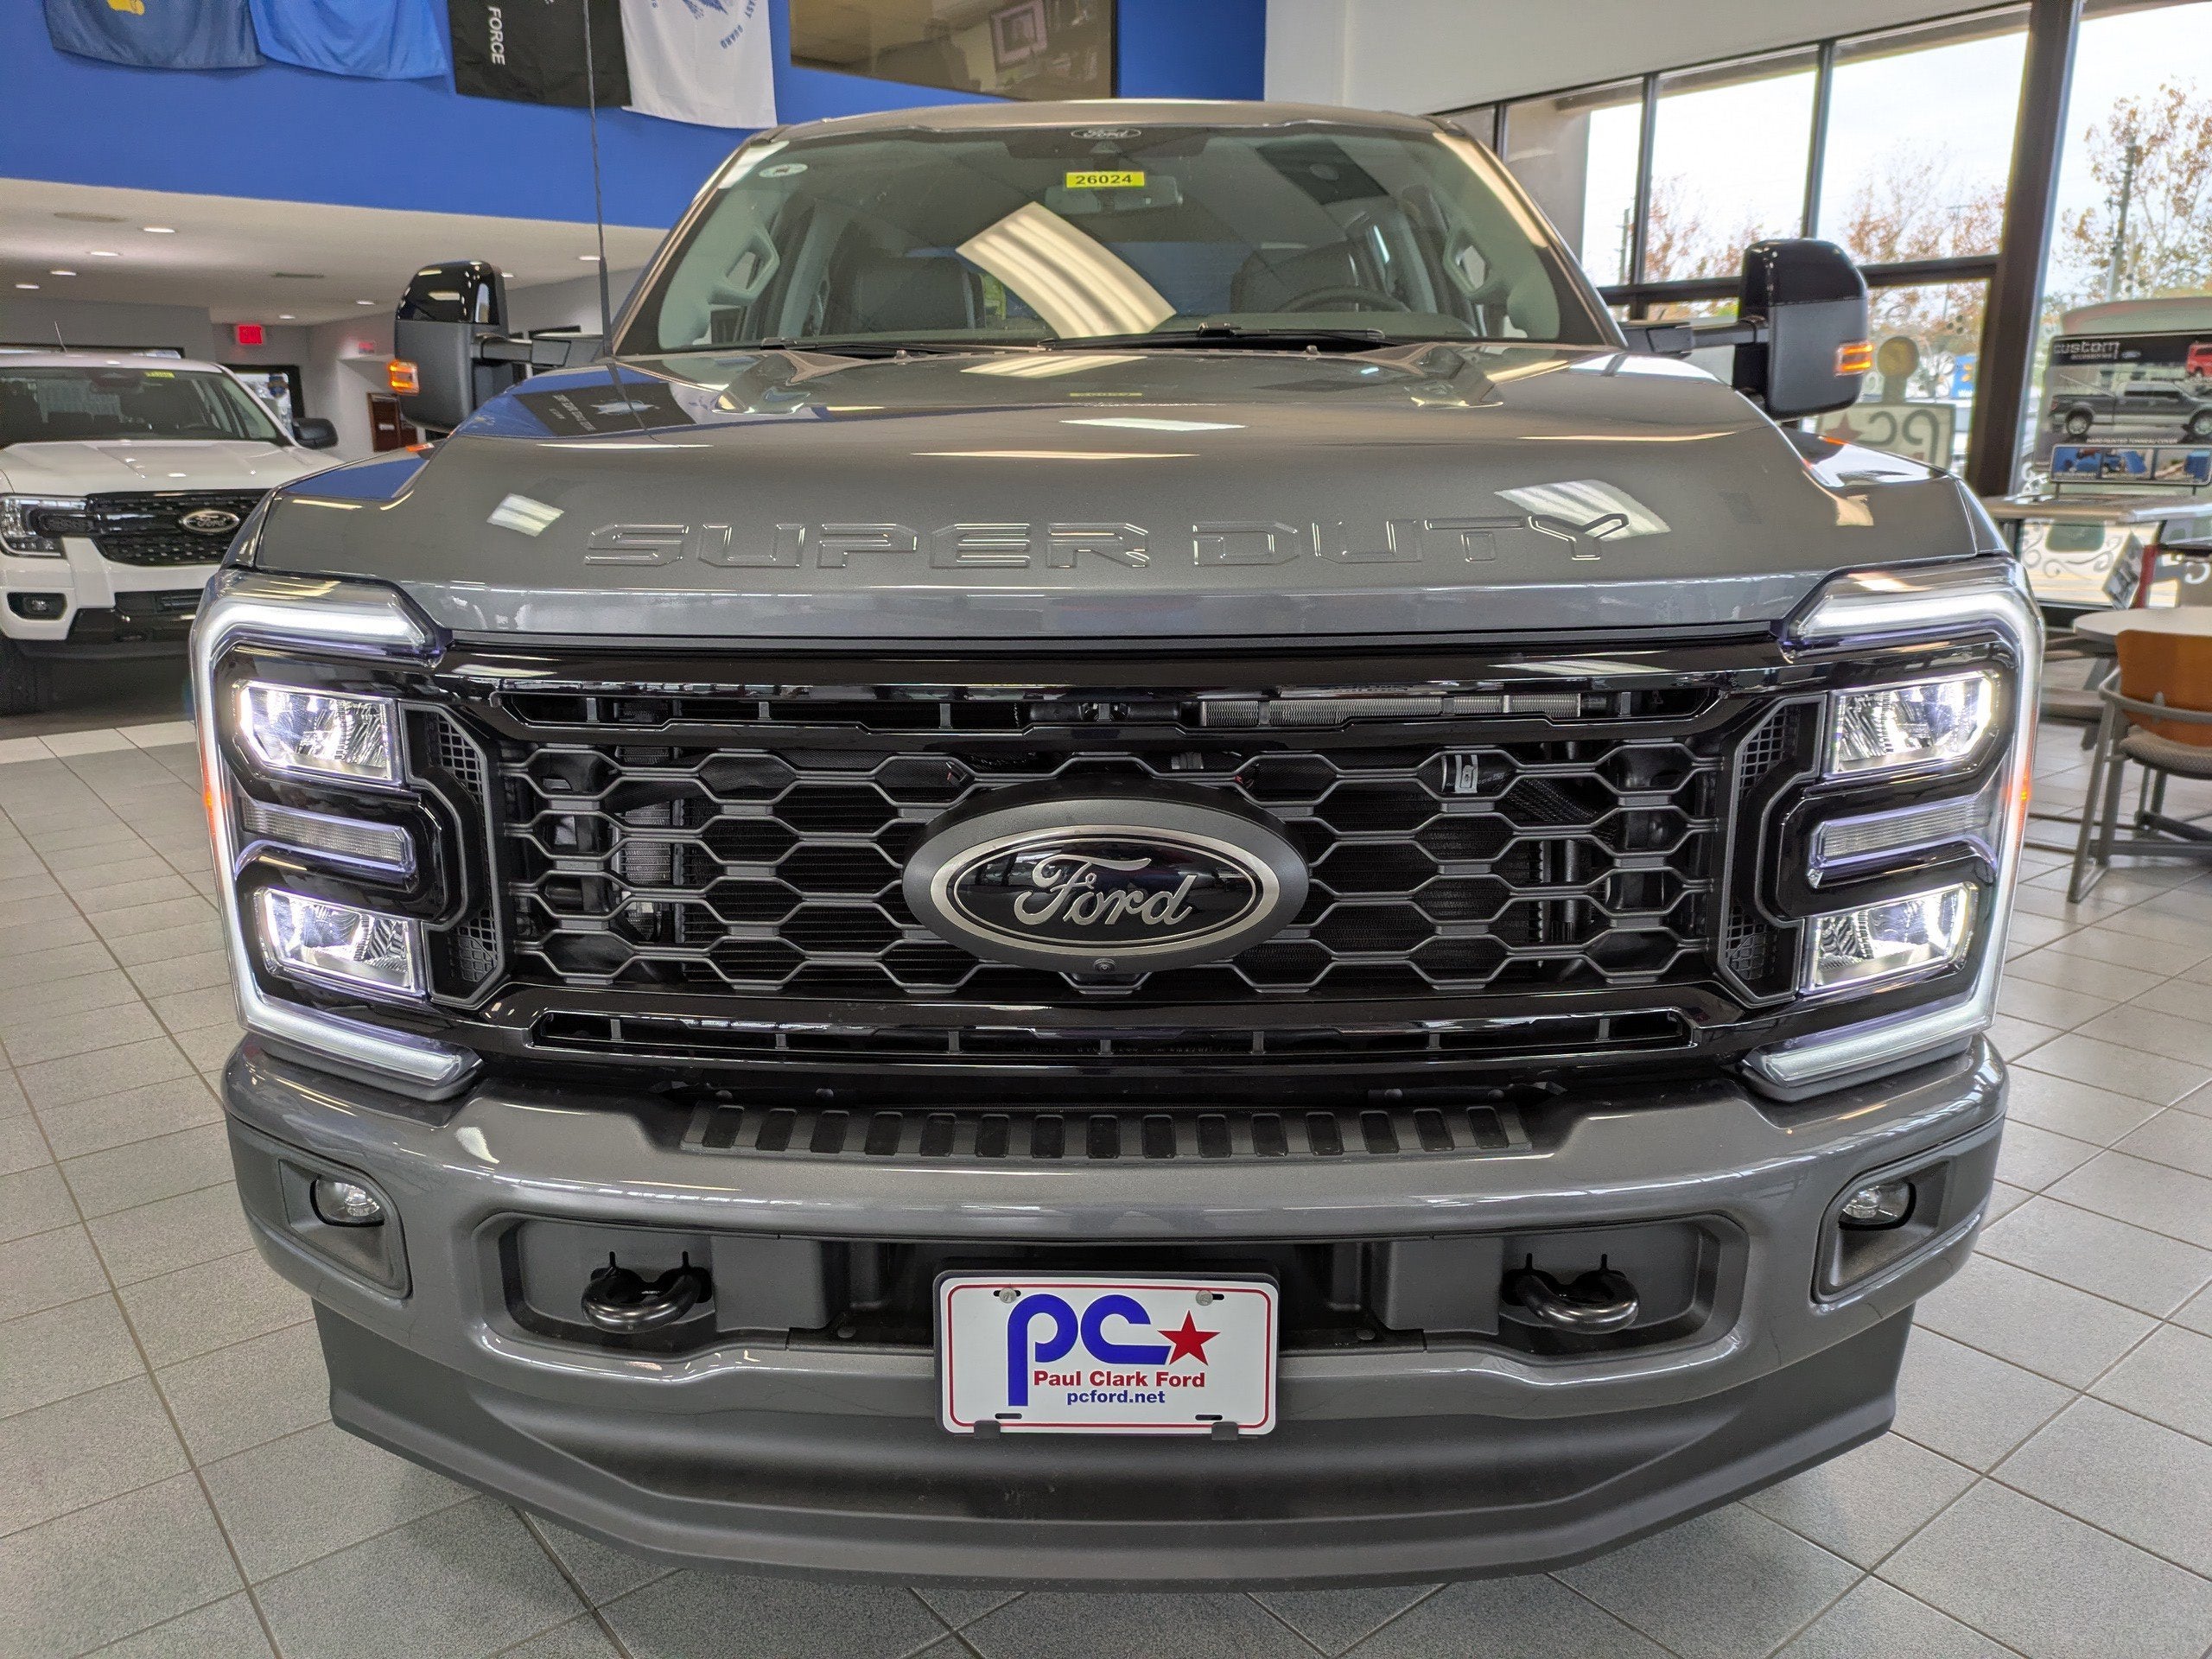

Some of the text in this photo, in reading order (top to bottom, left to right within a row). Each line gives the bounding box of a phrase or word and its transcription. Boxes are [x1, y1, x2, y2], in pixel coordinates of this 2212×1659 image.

[487, 6, 505, 66] FORCE
[1075, 174, 1132, 185] 26024
[2054, 340, 2120, 359] custom
[584, 513, 1630, 568] SUPER DUTY
[1014, 854, 1198, 925] Ford
[1033, 1370, 1205, 1388] Paul Clark Ford
[1066, 1389, 1166, 1406] pcford.net
